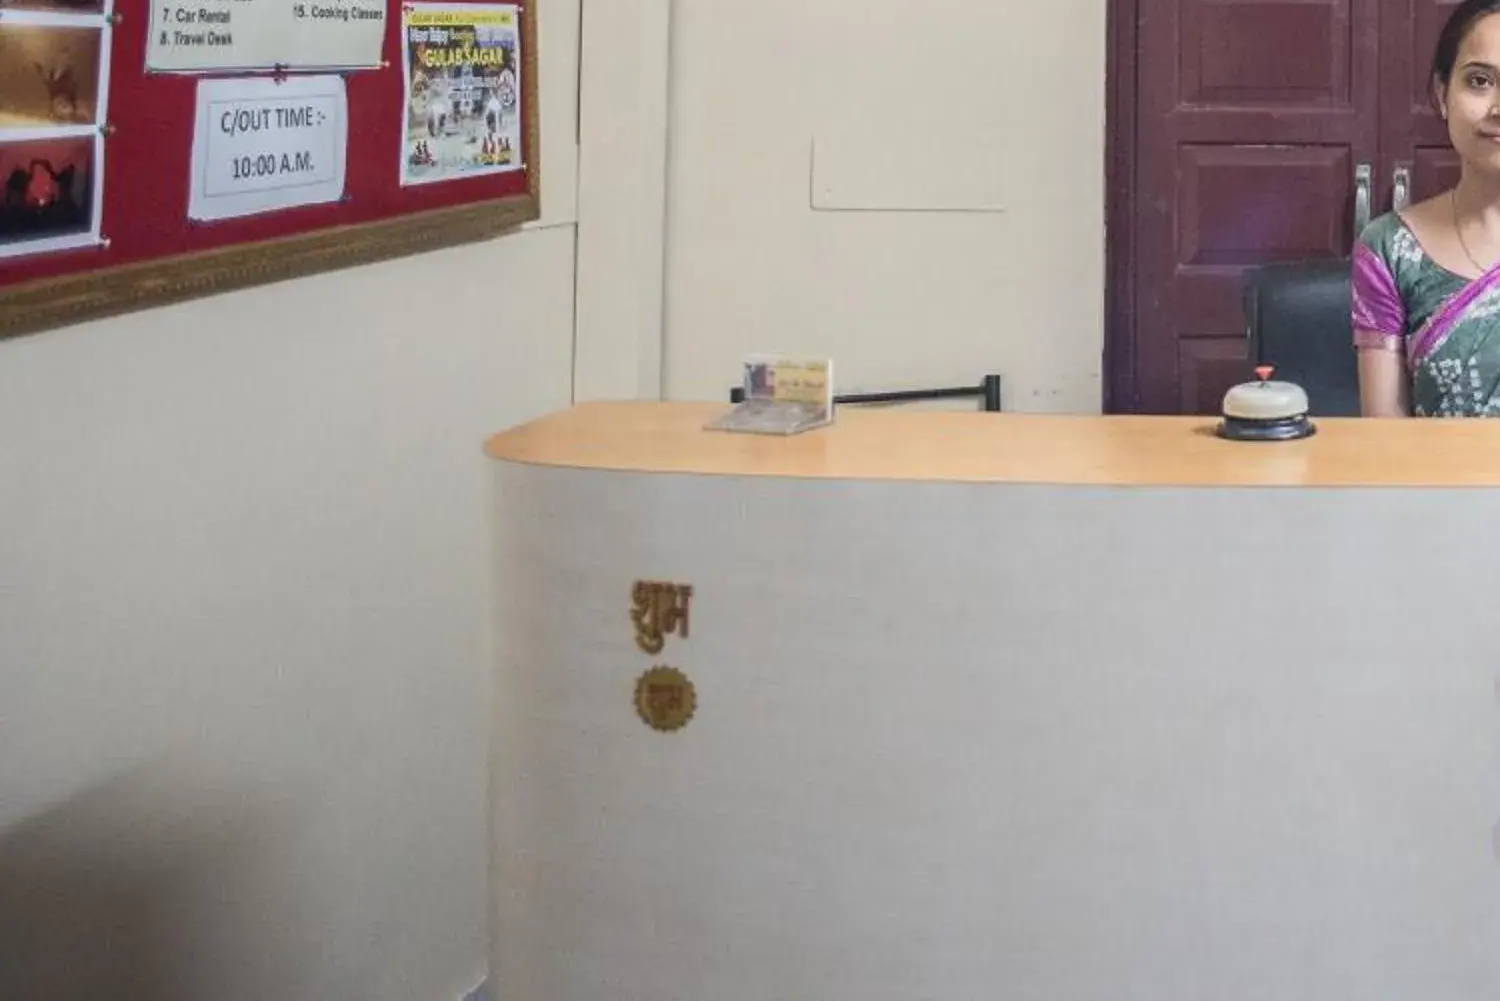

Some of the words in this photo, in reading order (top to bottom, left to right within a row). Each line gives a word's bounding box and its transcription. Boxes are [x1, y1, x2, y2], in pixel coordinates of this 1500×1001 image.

[175, 7, 197, 23] Car
[199, 8, 232, 23] Rental
[311, 4, 348, 22] Cooking
[351, 6, 383, 20] Classes
[174, 30, 205, 46] Travel
[207, 30, 233, 46] Desk
[220, 108, 271, 137] C/OUT
[275, 106, 313, 129] TIME
[233, 153, 276, 179] 10:00
[279, 150, 315, 175] A.M.
